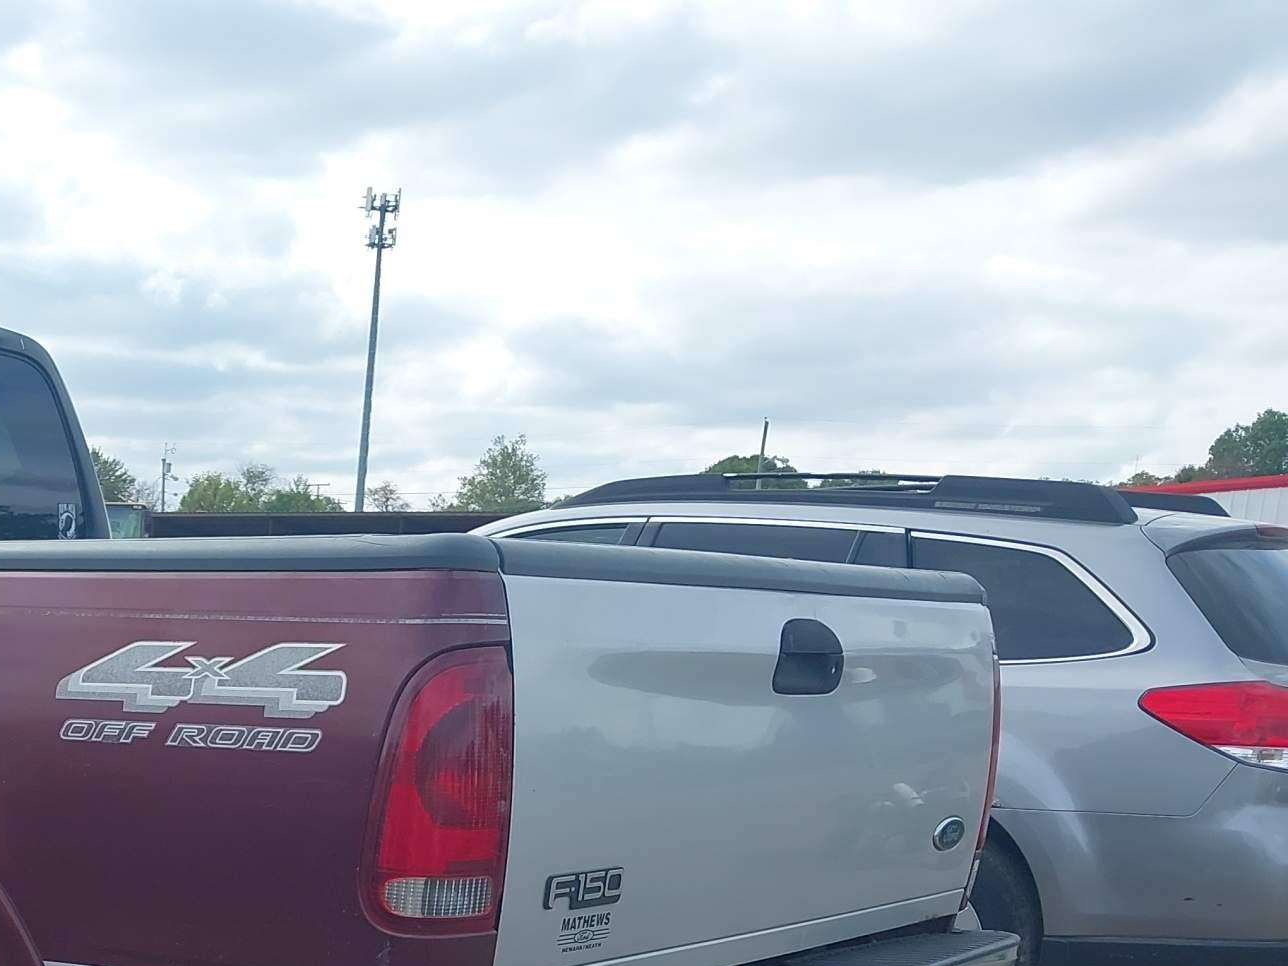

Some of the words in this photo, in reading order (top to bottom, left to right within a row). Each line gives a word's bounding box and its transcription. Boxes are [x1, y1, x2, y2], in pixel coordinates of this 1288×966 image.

[59, 719, 157, 744] OFF
[165, 723, 323, 752] ROAD
[561, 912, 611, 931] MATHEWS
